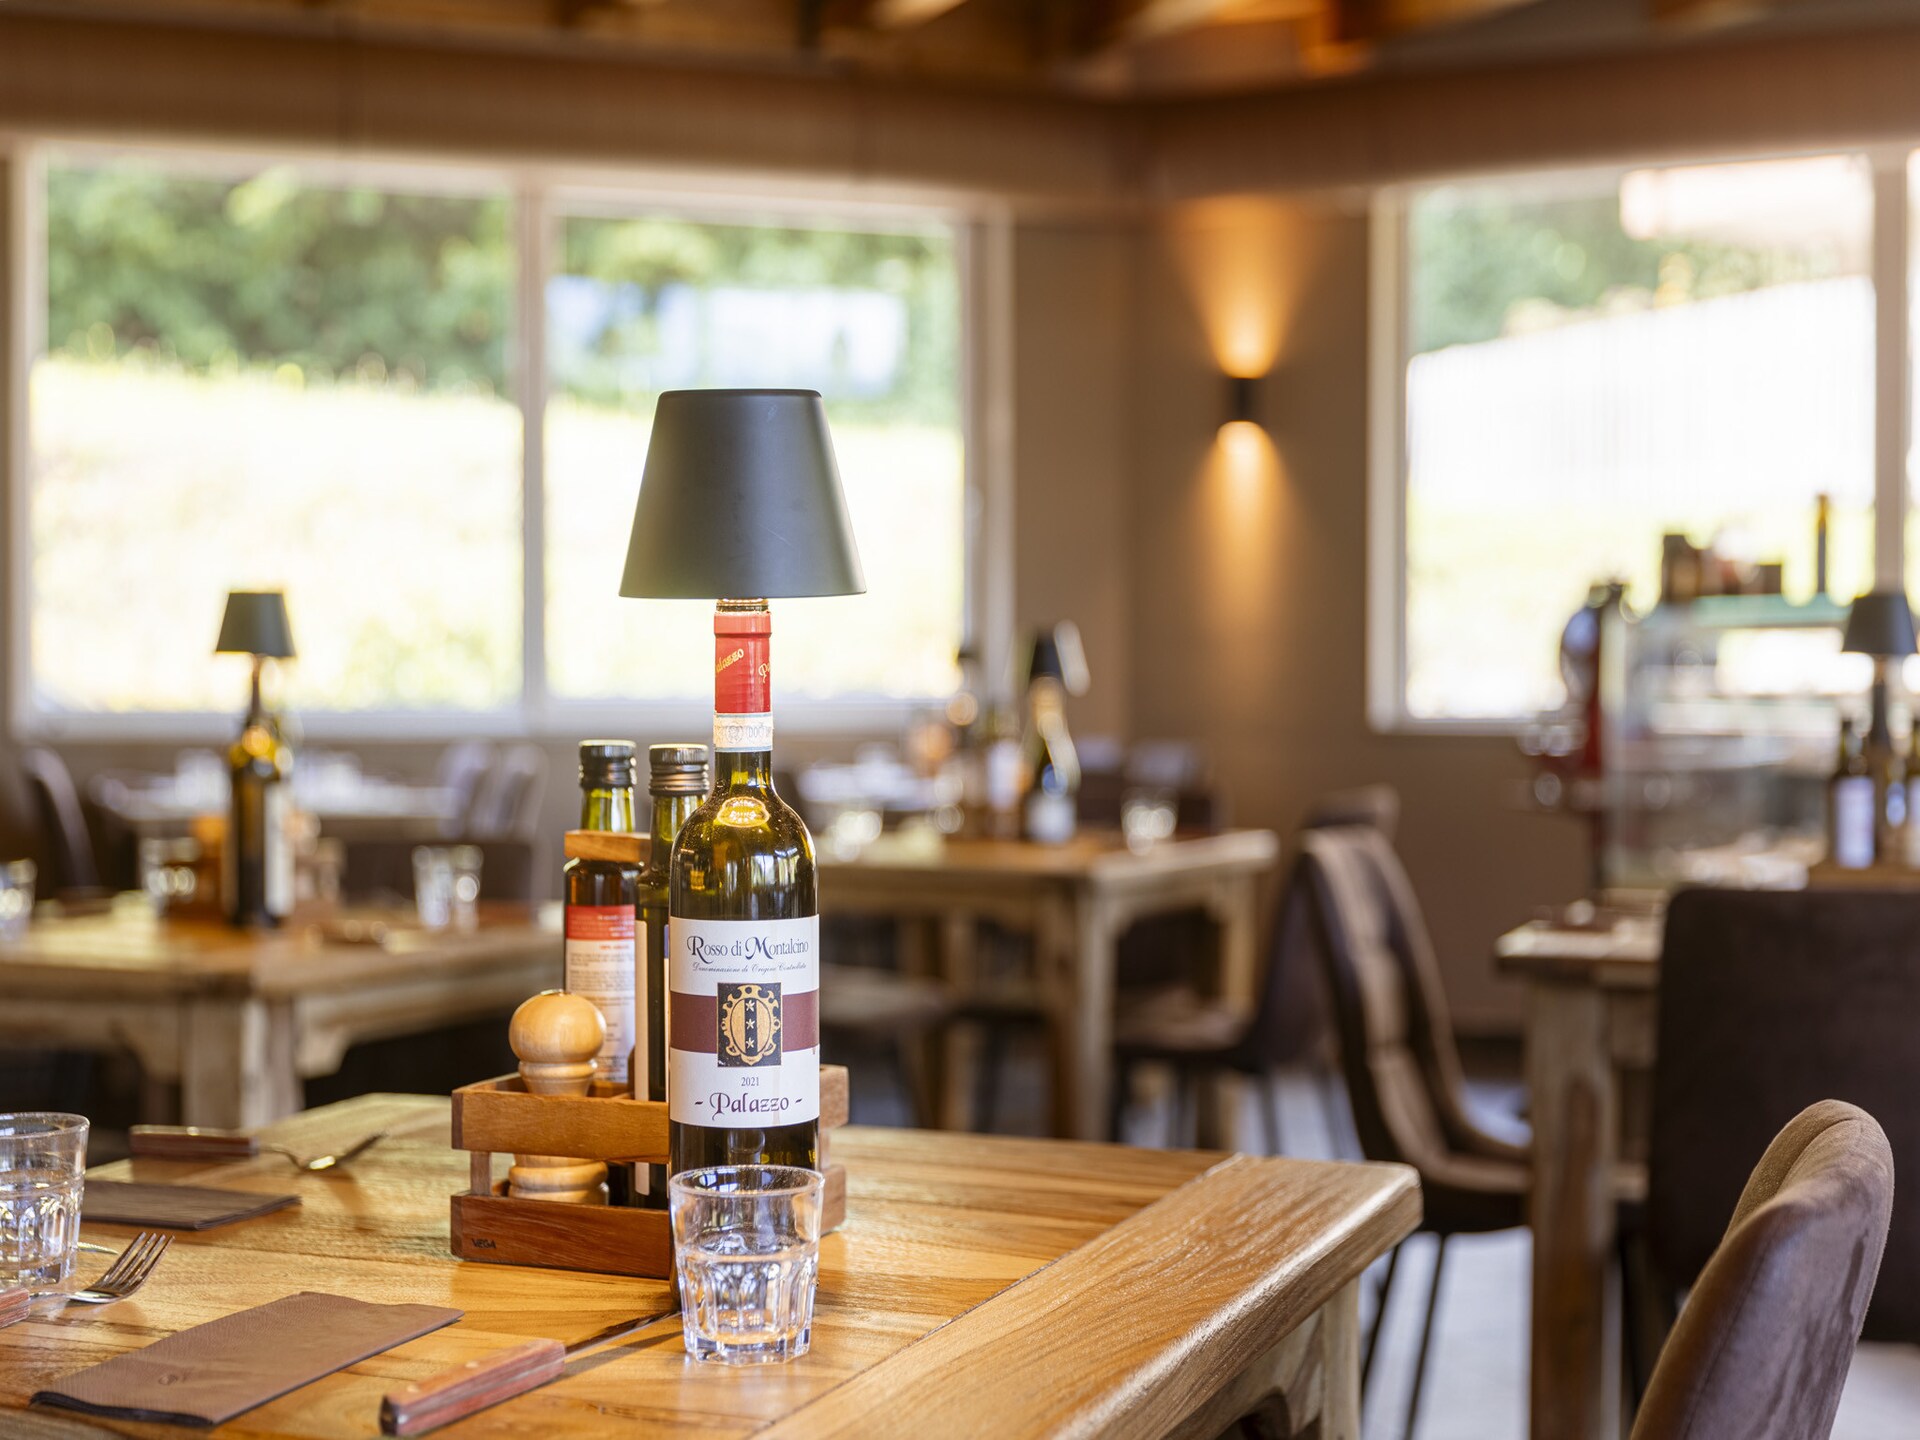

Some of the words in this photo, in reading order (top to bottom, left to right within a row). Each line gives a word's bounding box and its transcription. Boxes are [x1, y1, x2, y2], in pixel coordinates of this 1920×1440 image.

[715, 648, 744, 673] alazzo
[686, 935, 728, 965] Rosso
[731, 940, 742, 956] di
[745, 936, 809, 960] Montalcino
[741, 1076, 760, 1087] 2021
[709, 1092, 789, 1121] Palazzo
[471, 1237, 497, 1249] VEGA
